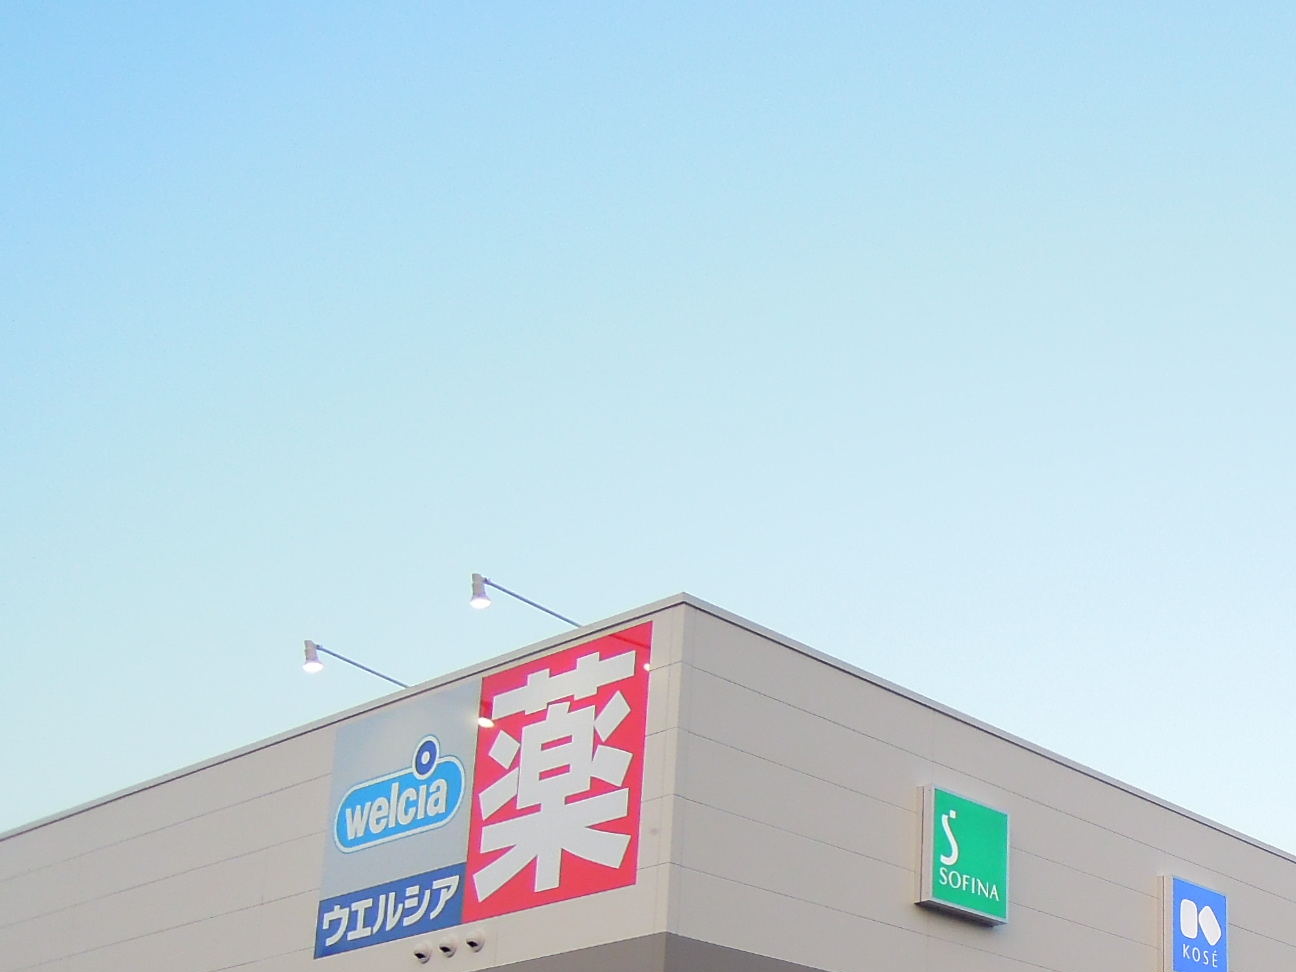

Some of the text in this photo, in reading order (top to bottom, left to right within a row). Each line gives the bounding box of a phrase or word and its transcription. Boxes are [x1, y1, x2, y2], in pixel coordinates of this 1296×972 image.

[345, 750, 447, 840] welcia
[473, 650, 636, 903] 薬
[322, 875, 460, 947] ウエルシア
[939, 867, 999, 902] SOFINA
[1183, 944, 1218, 968] KOSÉ
